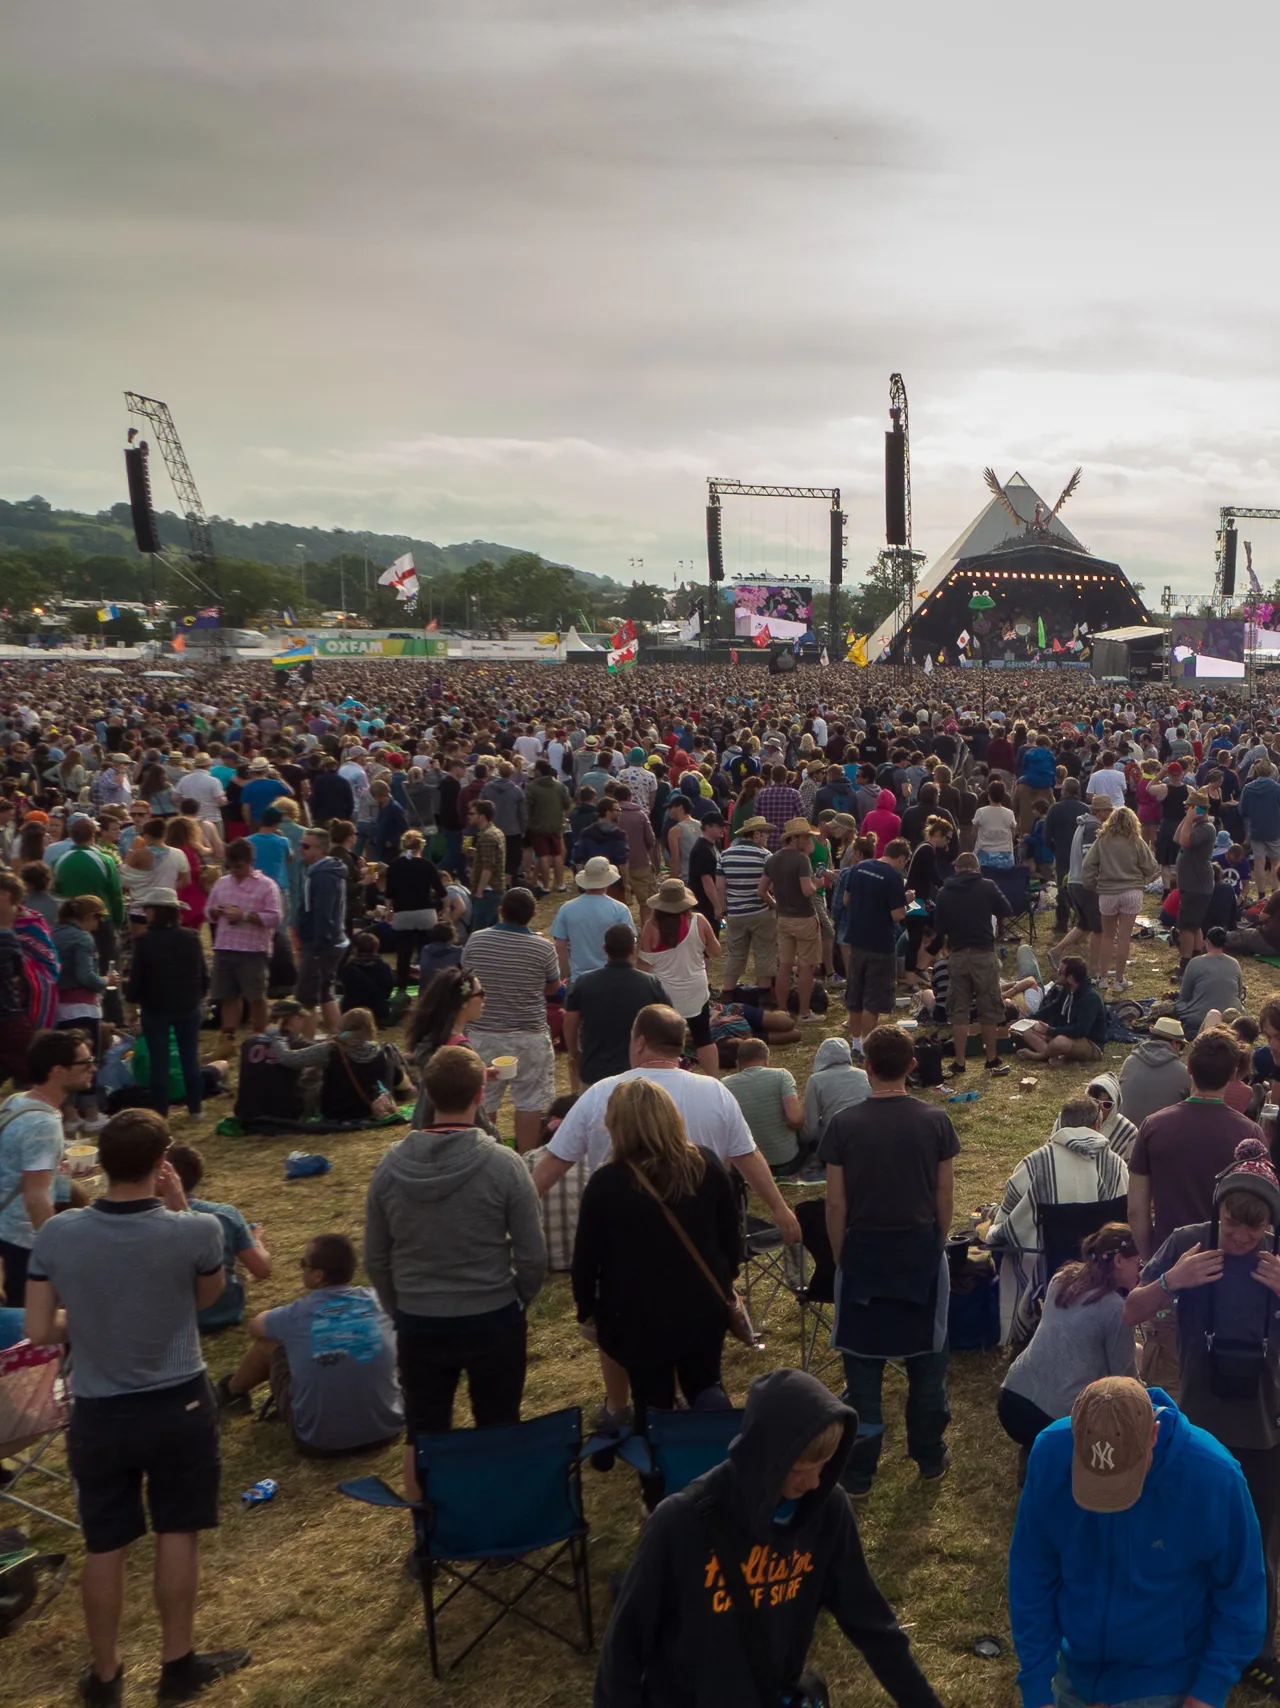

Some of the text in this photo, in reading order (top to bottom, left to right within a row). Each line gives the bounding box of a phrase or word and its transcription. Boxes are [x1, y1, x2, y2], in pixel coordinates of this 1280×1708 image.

[326, 640, 383, 654] OXFAM
[1091, 1441, 1115, 1470] NY
[704, 1544, 814, 1588] Hlliser
[712, 1577, 803, 1613] CAF SURF
